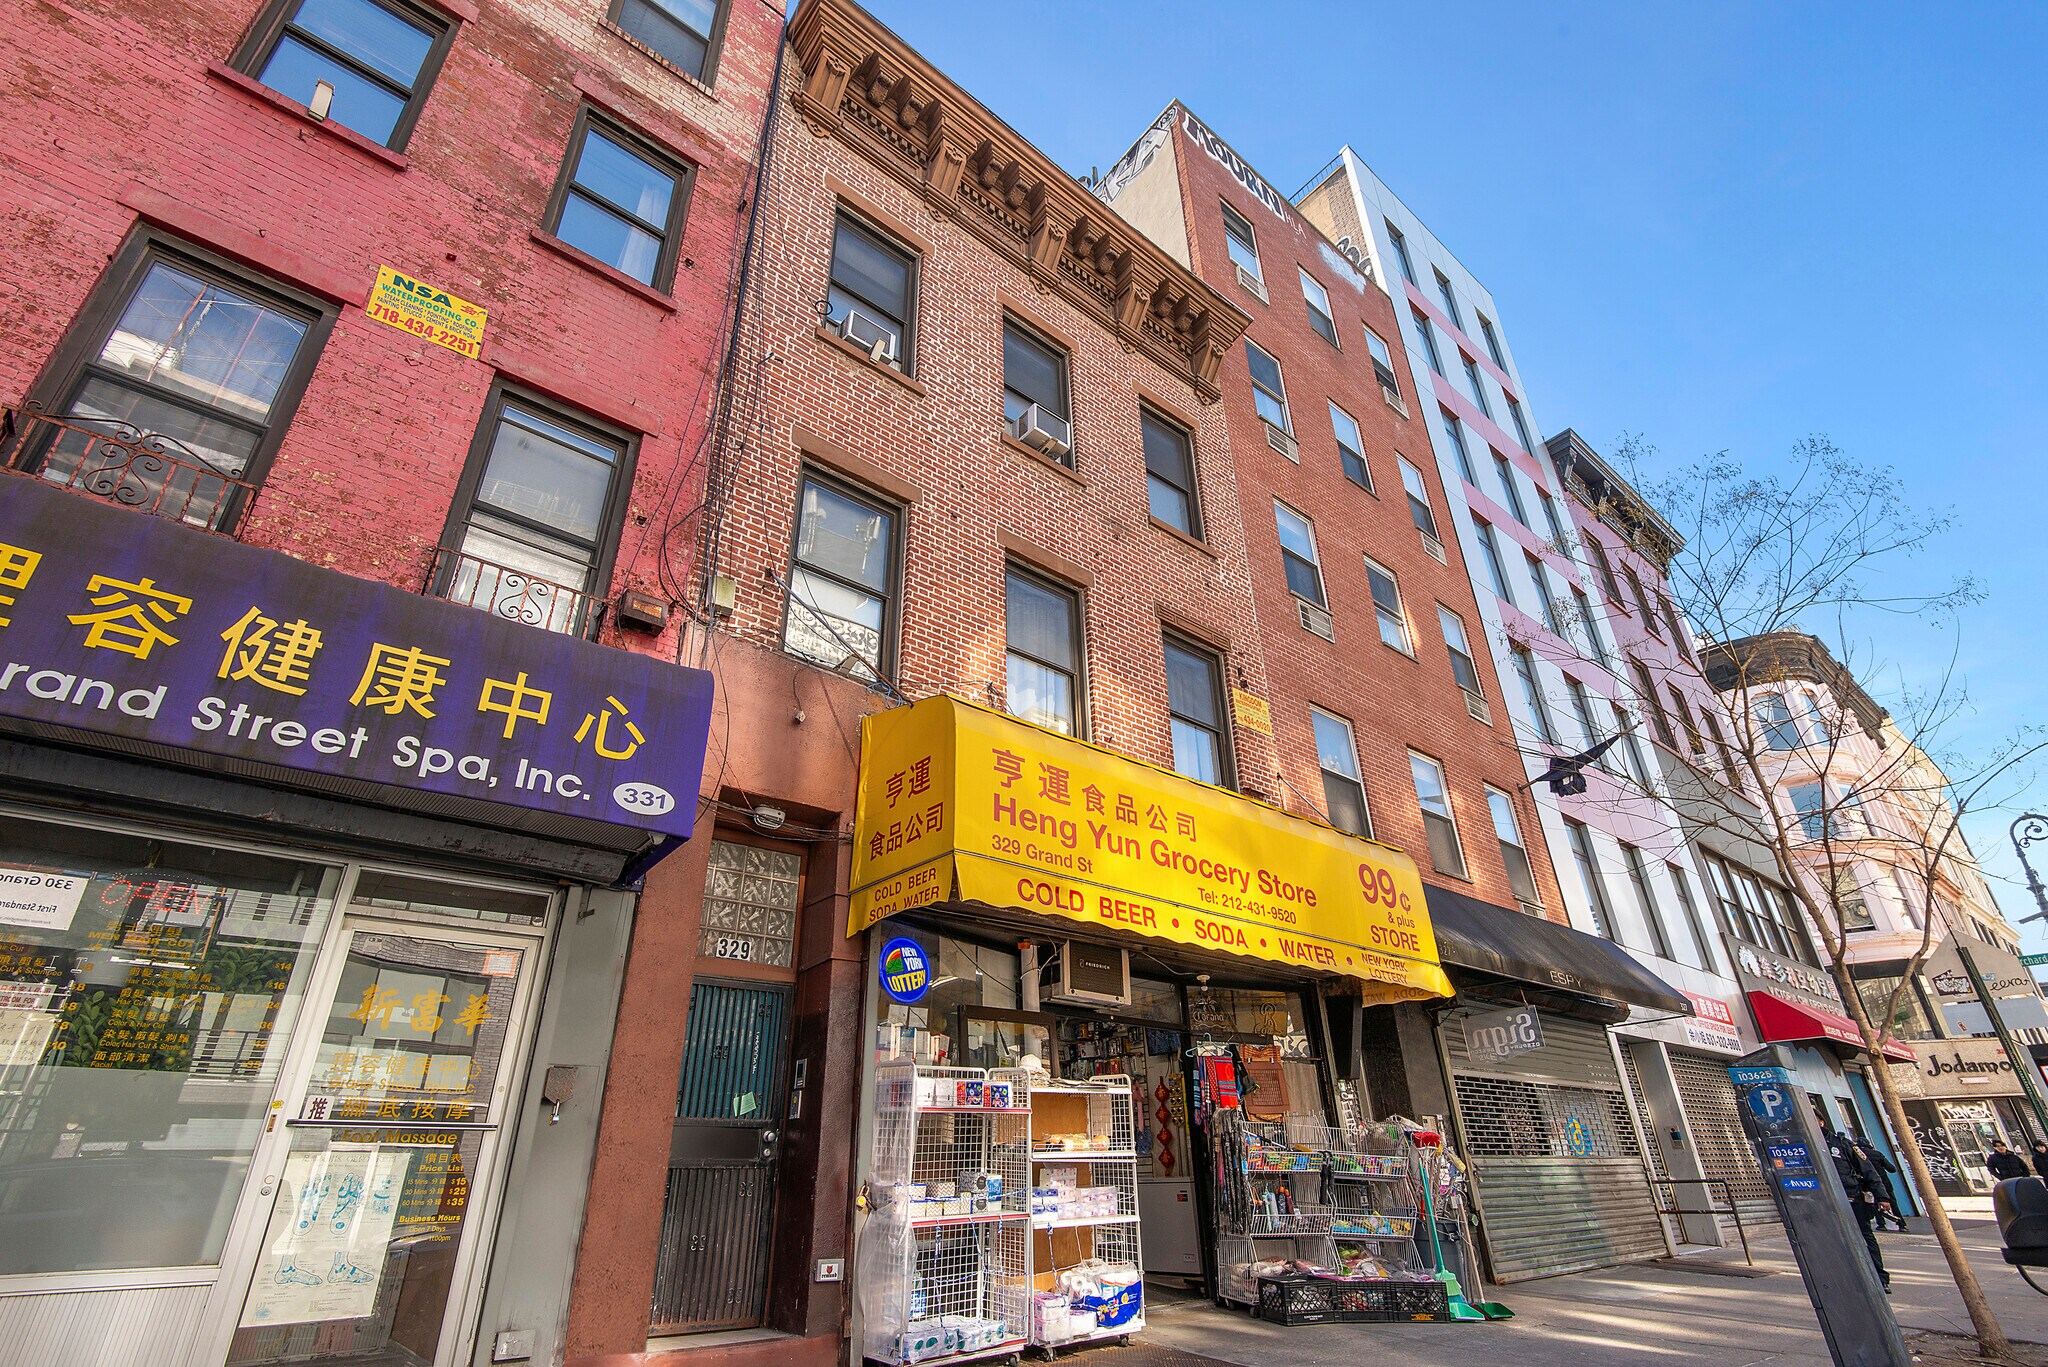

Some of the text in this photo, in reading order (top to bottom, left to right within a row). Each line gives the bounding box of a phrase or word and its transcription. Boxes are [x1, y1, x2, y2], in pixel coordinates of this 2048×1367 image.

[393, 275, 452, 308] NSA
[381, 283, 479, 329] WATERPROOFING CO.
[373, 303, 474, 354] 718-434-2251
[191, 696, 369, 759] Street
[392, 735, 498, 787] Spa,
[514, 758, 590, 800] Inc.
[886, 755, 931, 809] 亨運
[622, 787, 666, 810] 331
[992, 748, 1197, 843] 亨運食品公司
[869, 801, 944, 861] 食品公司
[991, 835, 1094, 874] 329 Grand St
[993, 792, 1317, 907] Heng Yun Grocery Store
[874, 867, 936, 902] COLD BEER
[100, 879, 212, 914] OPEN
[869, 885, 940, 922] SODA WATER
[1197, 887, 1297, 925] Tel: 212-431-9520
[1017, 878, 1337, 967] COLD BEER SODA WATER
[1387, 911, 1415, 929] & plus
[88, 931, 120, 941] MEN
[167, 940, 195, 949] CUT
[718, 938, 749, 959] 329
[1370, 924, 1420, 952] STORE
[901, 947, 917, 957] NEW
[1361, 953, 1408, 972] NEW YORK
[904, 957, 924, 971] YORK
[1085, 961, 1111, 970] FRIEDRICH
[887, 970, 926, 992] LOTTERY
[1369, 967, 1408, 985] LOTTERY
[1550, 970, 1582, 987] ESPY
[350, 983, 492, 1036] 新富華
[90, 1061, 113, 1069] Facial
[1738, 1071, 1772, 1082] 103625
[308, 1098, 328, 1119] 推
[1761, 1090, 1782, 1117] P
[341, 1129, 458, 1145] Foot Massage
[1772, 1148, 1805, 1157] 103625
[449, 1187, 466, 1195] $25
[451, 1177, 467, 1186] $15
[446, 1197, 464, 1206] $35
[437, 1214, 461, 1222] Hours
